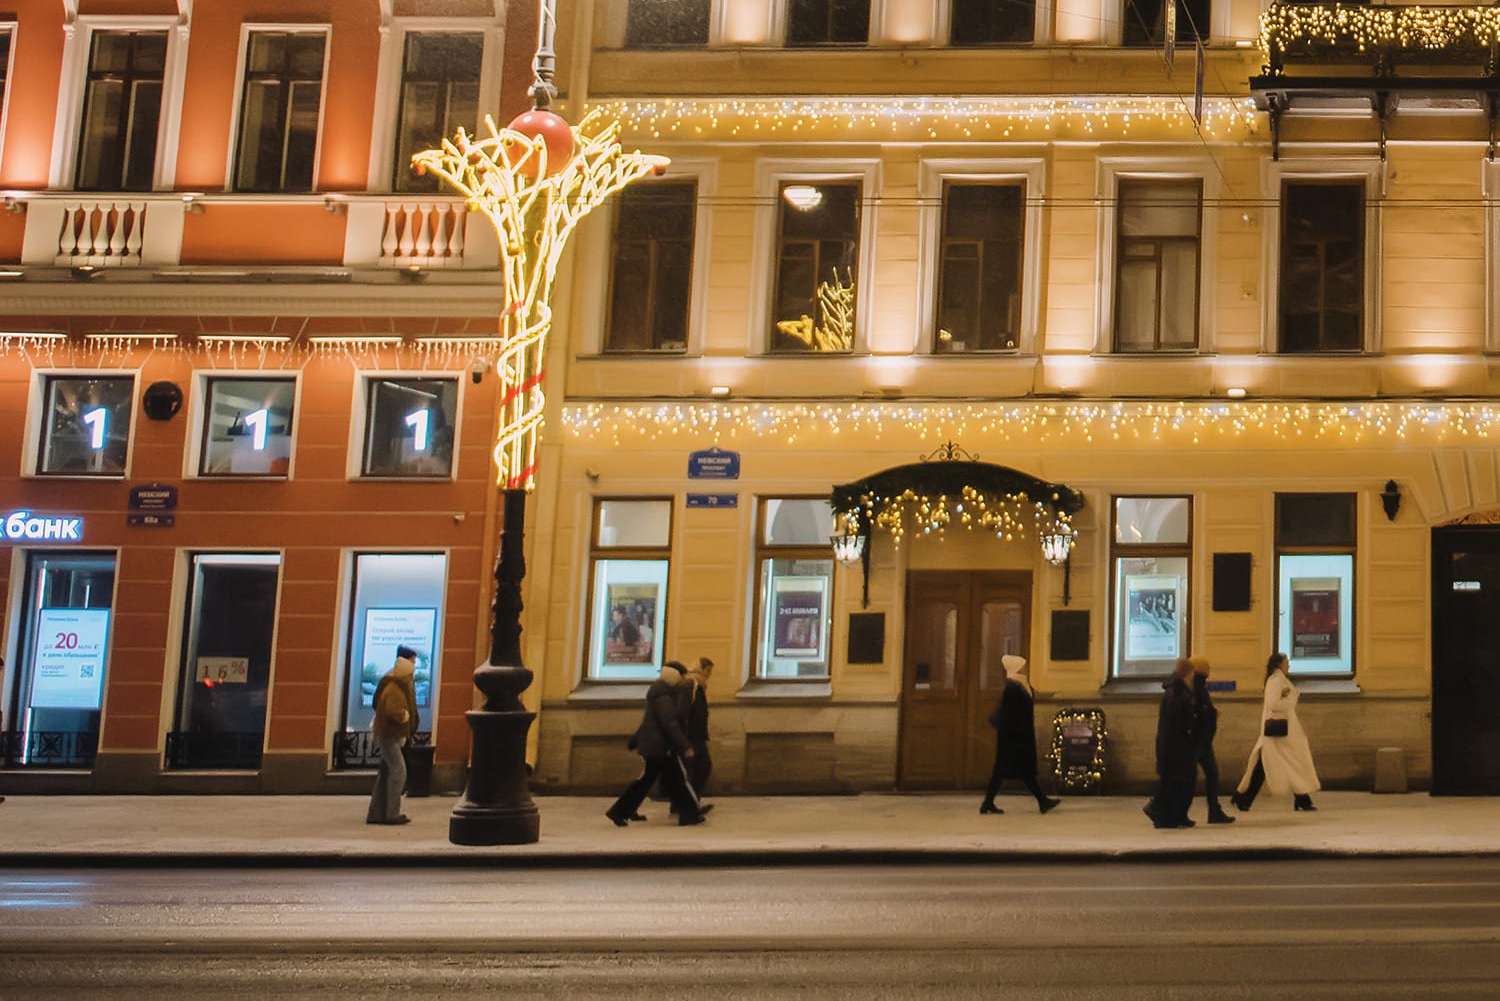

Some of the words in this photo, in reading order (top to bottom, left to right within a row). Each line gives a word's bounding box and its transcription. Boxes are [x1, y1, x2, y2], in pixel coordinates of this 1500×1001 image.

[84, 408, 106, 448] 1
[245, 409, 268, 450] 1
[405, 409, 429, 450] 1
[55, 632, 78, 649] 20
